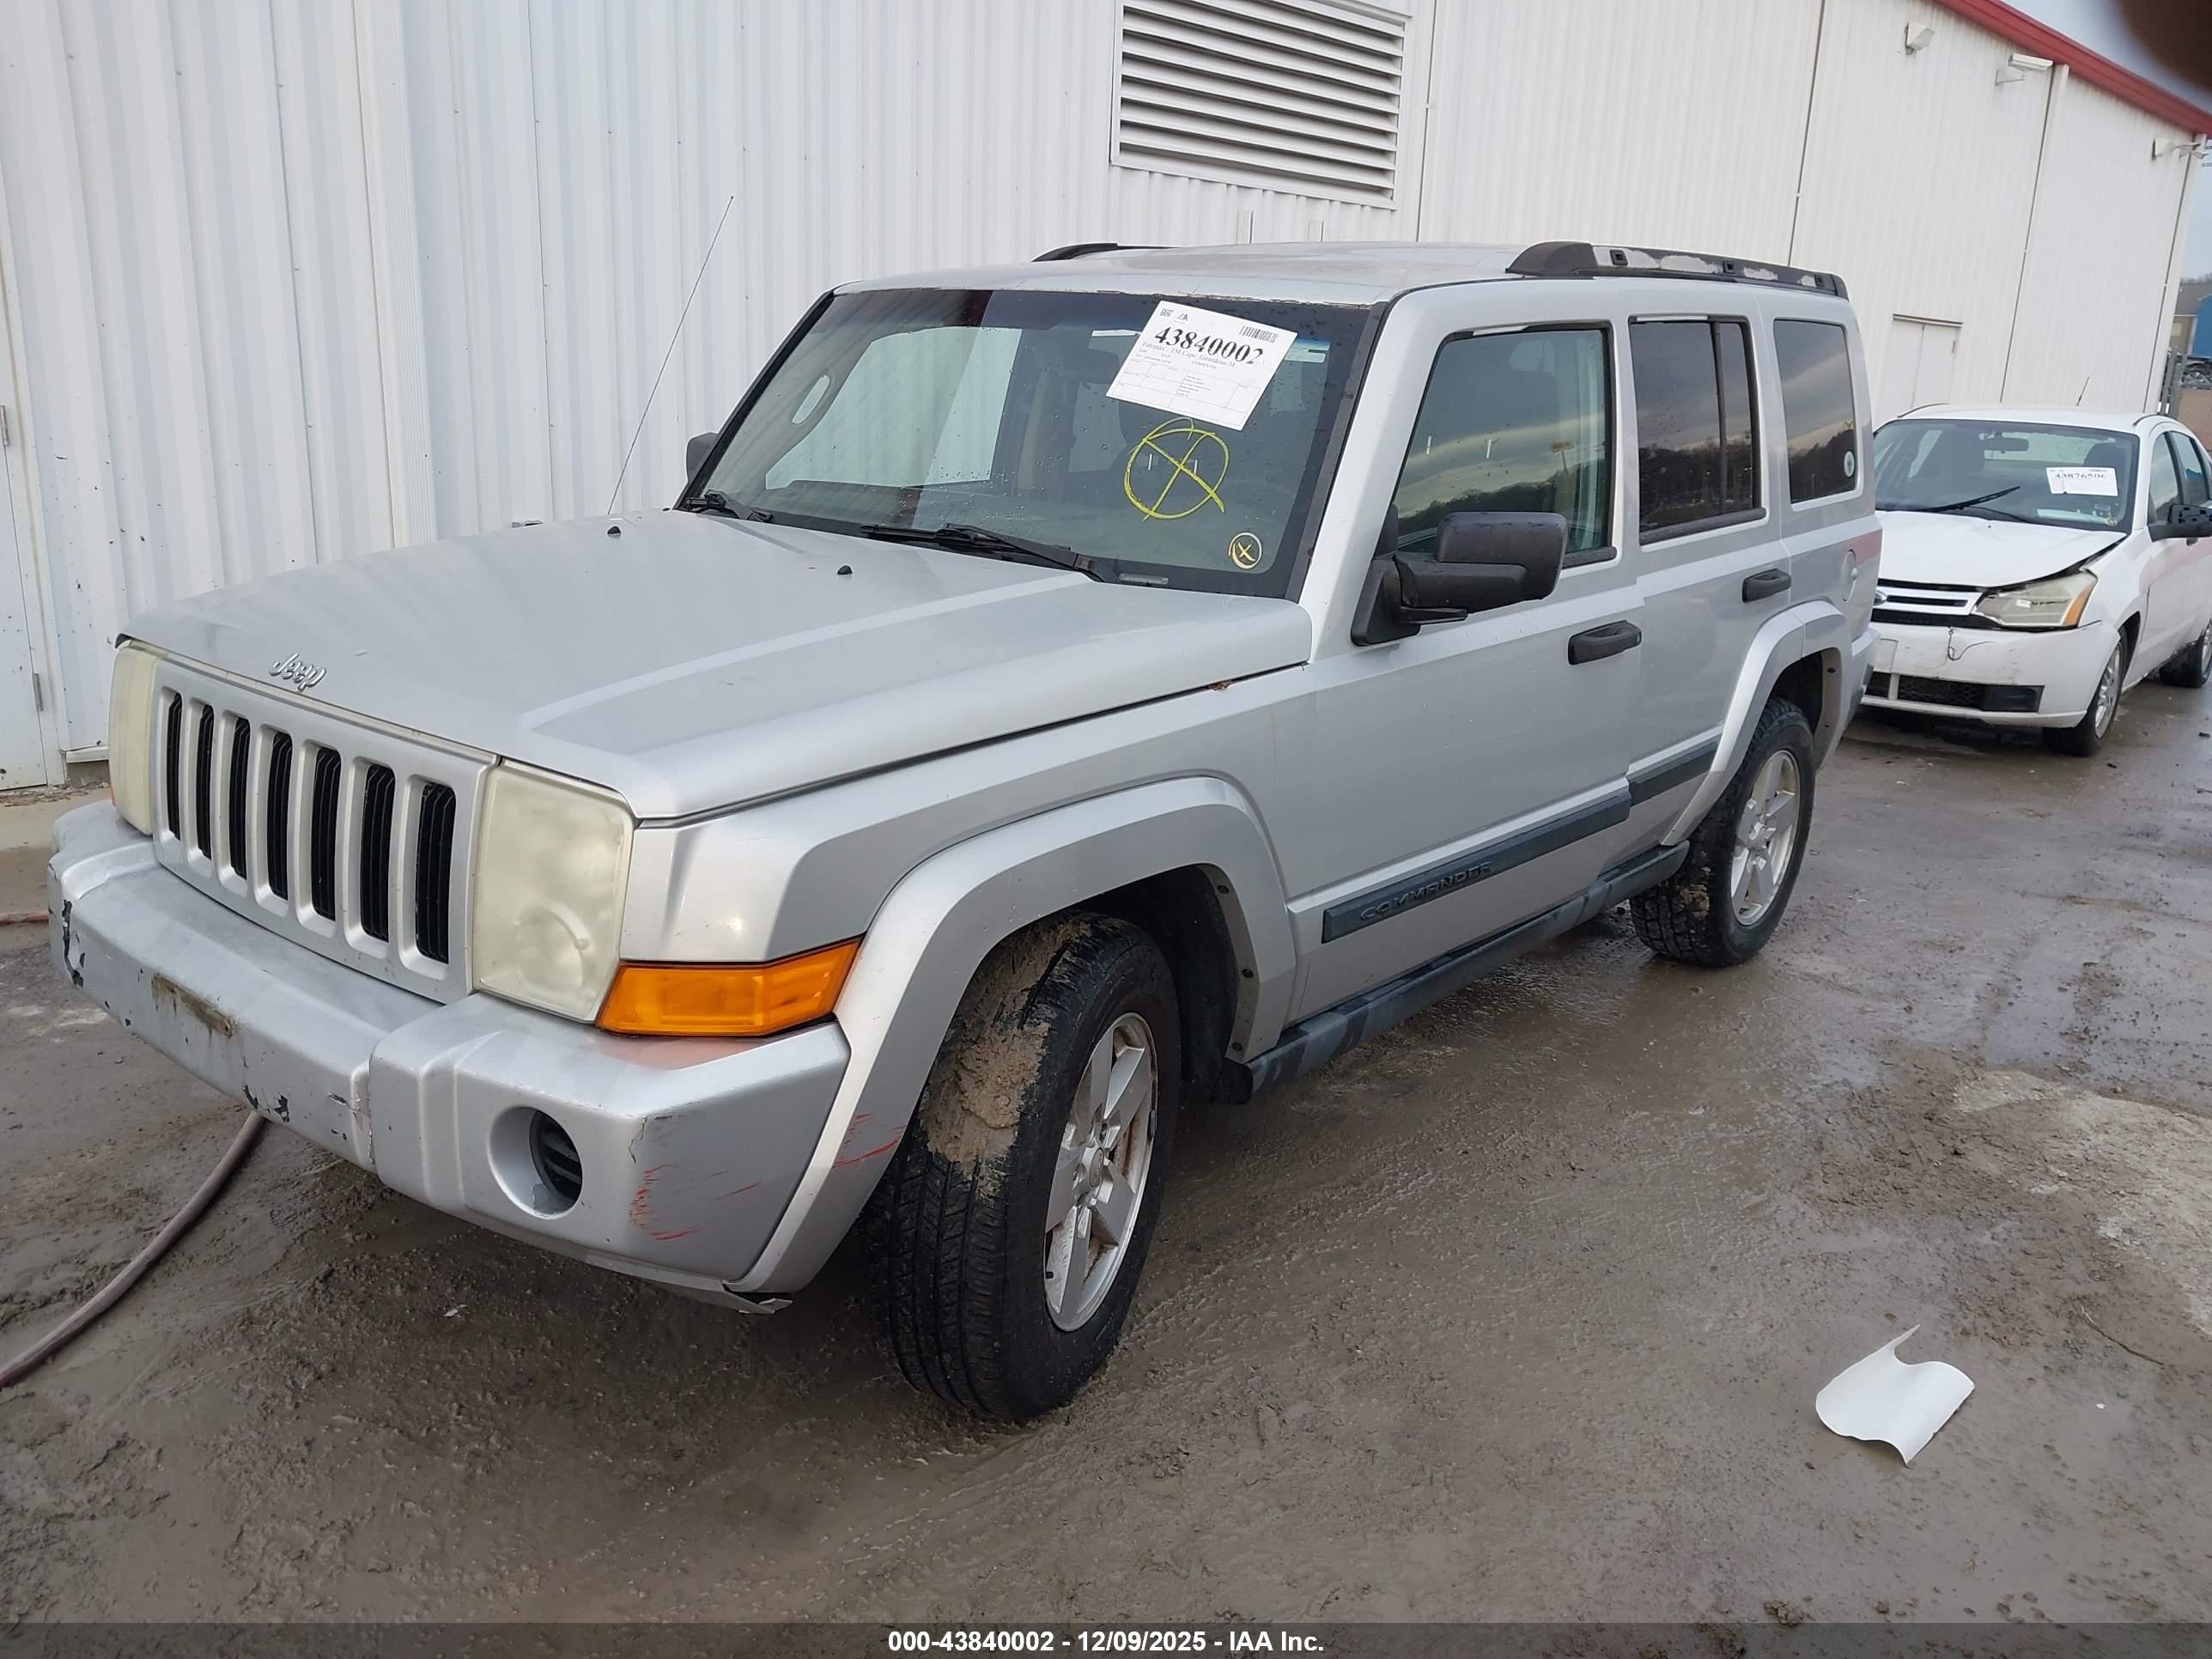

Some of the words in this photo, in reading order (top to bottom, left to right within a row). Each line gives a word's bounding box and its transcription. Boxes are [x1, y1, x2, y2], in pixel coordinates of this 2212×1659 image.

[1155, 326, 1264, 364] 43840002
[269, 653, 326, 692] Jeep
[1360, 861, 1492, 921] COMMANDER
